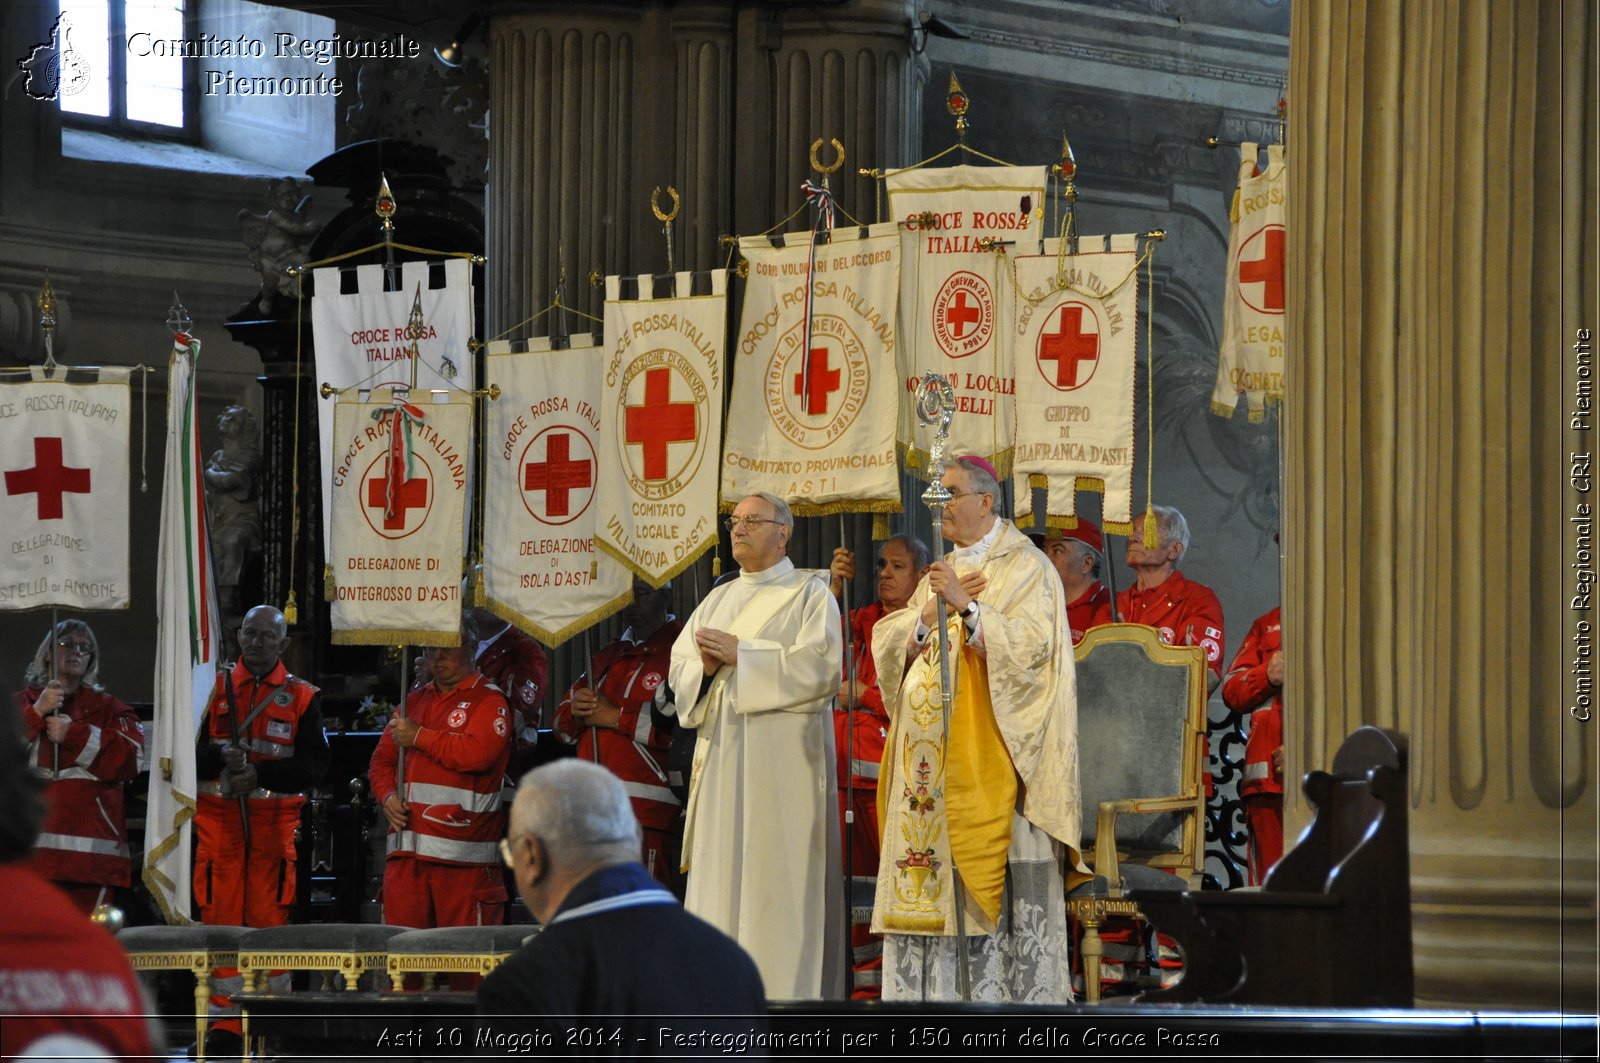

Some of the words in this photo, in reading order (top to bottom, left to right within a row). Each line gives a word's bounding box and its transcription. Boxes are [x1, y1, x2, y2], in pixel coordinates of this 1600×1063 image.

[833, 256, 849, 271] DEL
[978, 287, 988, 298] 22
[782, 281, 838, 309] ROSA
[843, 284, 895, 353] ITALIANA
[981, 300, 992, 335] AGOSTO
[352, 328, 389, 346] CROCE
[784, 332, 799, 349] DI
[963, 335, 983, 350] 1864
[606, 329, 631, 388] CROCE
[632, 313, 677, 338] ROSSA
[680, 317, 720, 390] ITALIANA
[845, 339, 860, 357] 22
[845, 360, 865, 412] AGOSTO
[768, 351, 806, 443] CONVENZIONE
[26, 394, 64, 412] ROSSA
[68, 400, 118, 425] ITALIANA
[1044, 405, 1091, 422] GRUPPO
[503, 415, 528, 461] CROCE
[531, 397, 569, 419] ROSSA
[1060, 426, 1070, 438] DI
[335, 435, 364, 487] CROCE
[418, 423, 465, 490] ITALIANA
[726, 452, 802, 475] COMITATO
[806, 450, 893, 474] PROVINCIALE
[787, 476, 836, 496] ASTI
[632, 502, 686, 518] COMITATO
[606, 514, 669, 568] VILLANOVA
[636, 525, 679, 540] LOCALE
[12, 533, 84, 554] DELEGAZIONE
[519, 538, 594, 556] DELEGAZIONE
[43, 555, 54, 565] DI
[348, 557, 421, 570] DELEGAZIONE
[427, 558, 440, 571] DI
[551, 557, 559, 567] DI
[64, 579, 117, 599] ANNONE
[520, 573, 550, 588] ISOLA
